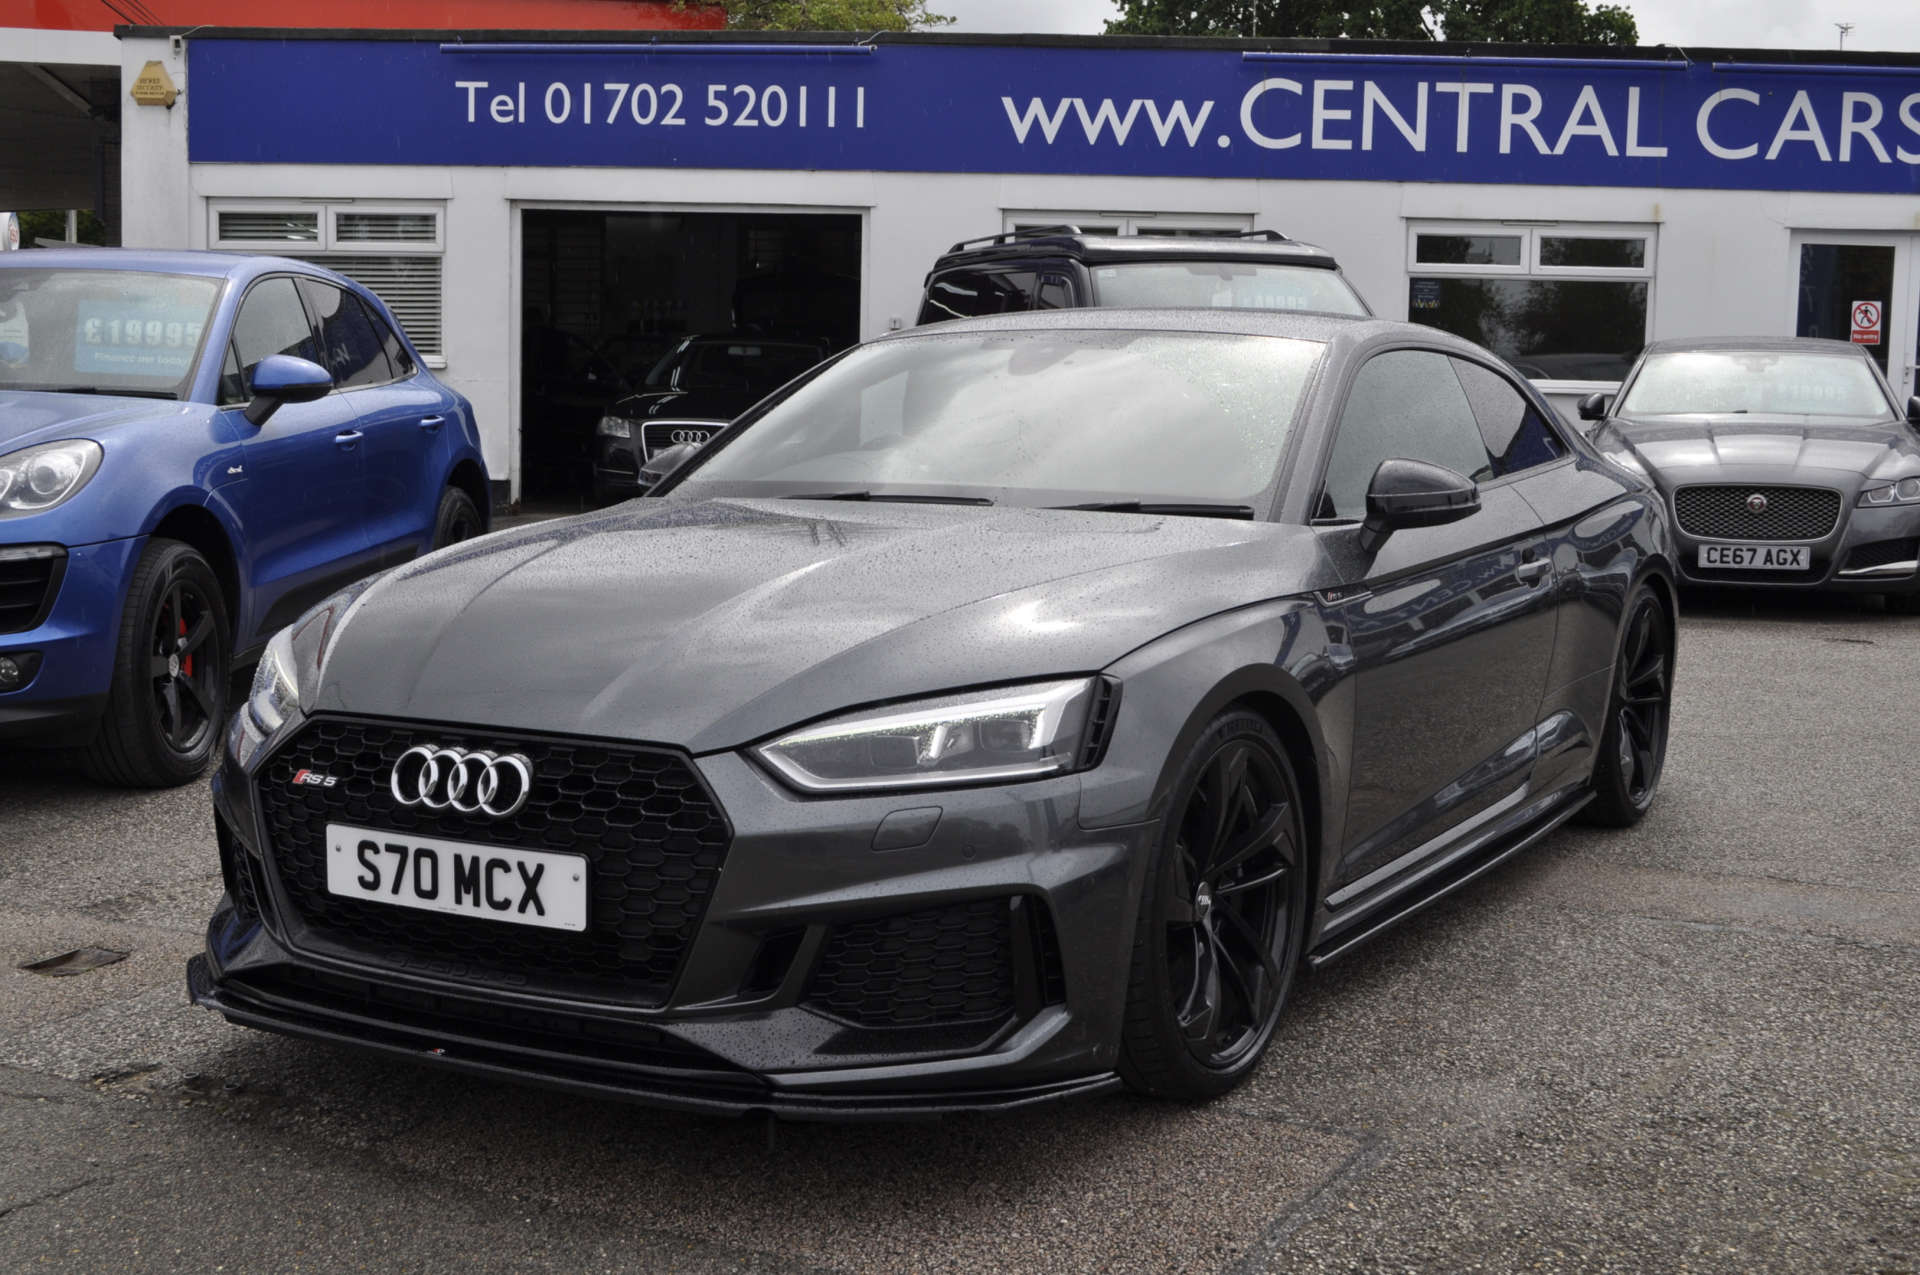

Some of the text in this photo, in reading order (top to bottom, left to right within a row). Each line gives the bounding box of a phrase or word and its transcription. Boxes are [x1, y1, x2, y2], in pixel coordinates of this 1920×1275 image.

[455, 80, 865, 129] Tel 01702 520111
[1000, 77, 1920, 165] www.CENTRAL CARS
[1706, 546, 1801, 566] CE67 AGX
[357, 839, 546, 917] S70 MCX
